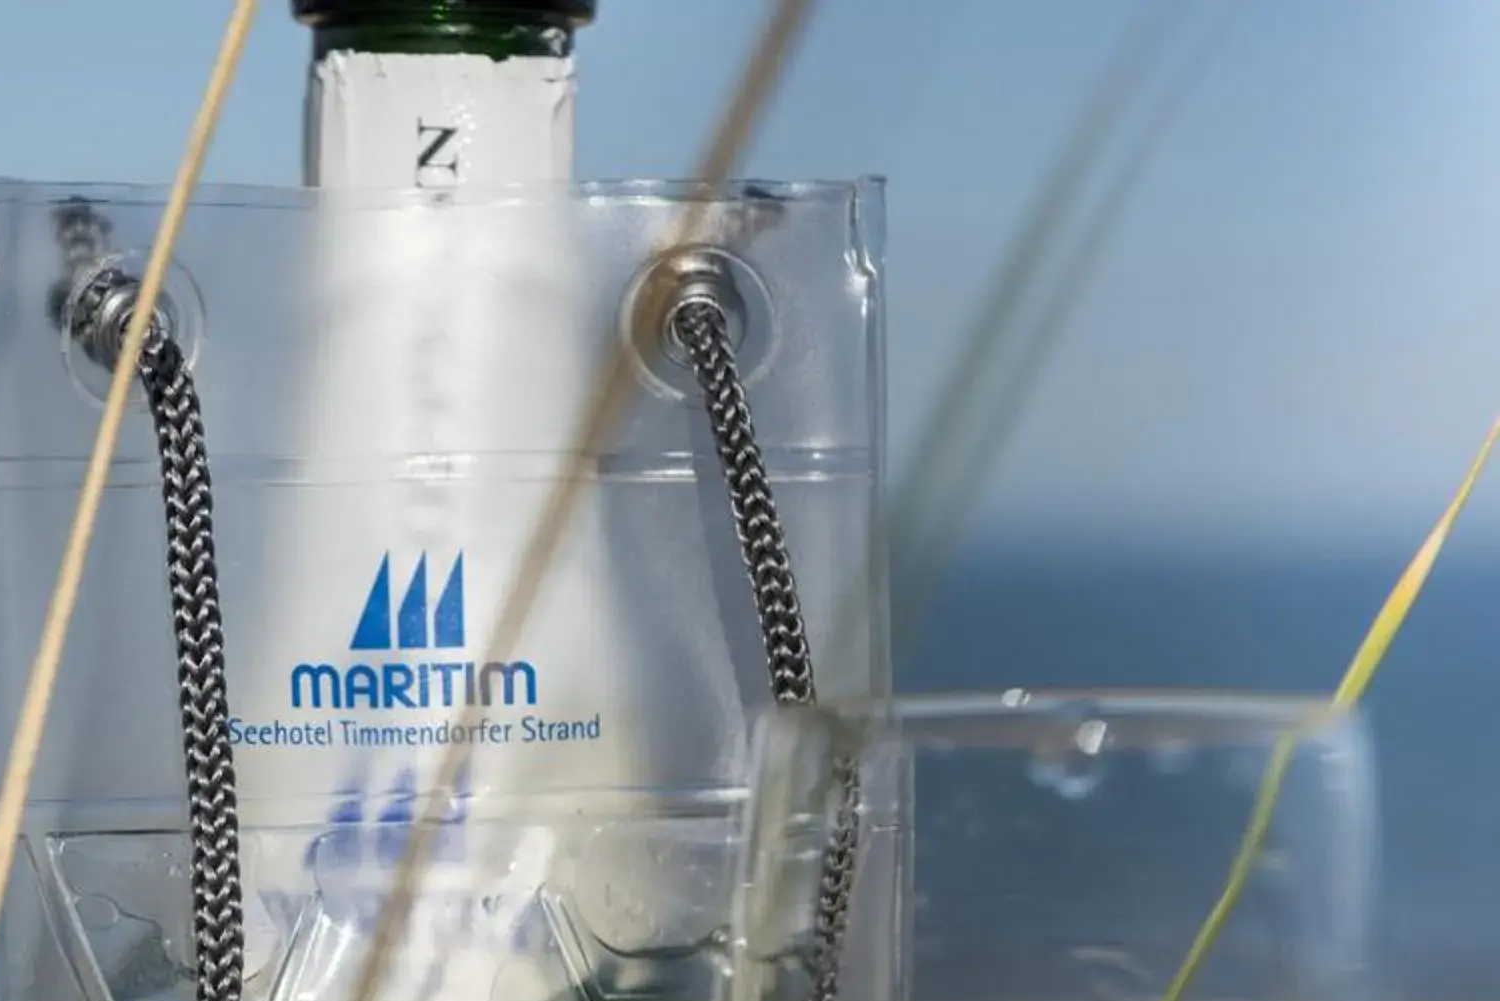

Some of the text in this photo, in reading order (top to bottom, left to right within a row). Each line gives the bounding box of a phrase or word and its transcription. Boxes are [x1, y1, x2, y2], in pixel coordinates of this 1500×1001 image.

[290, 660, 538, 709] MARITIM
[228, 713, 601, 746] Seehotel Timmendorfer Strand
